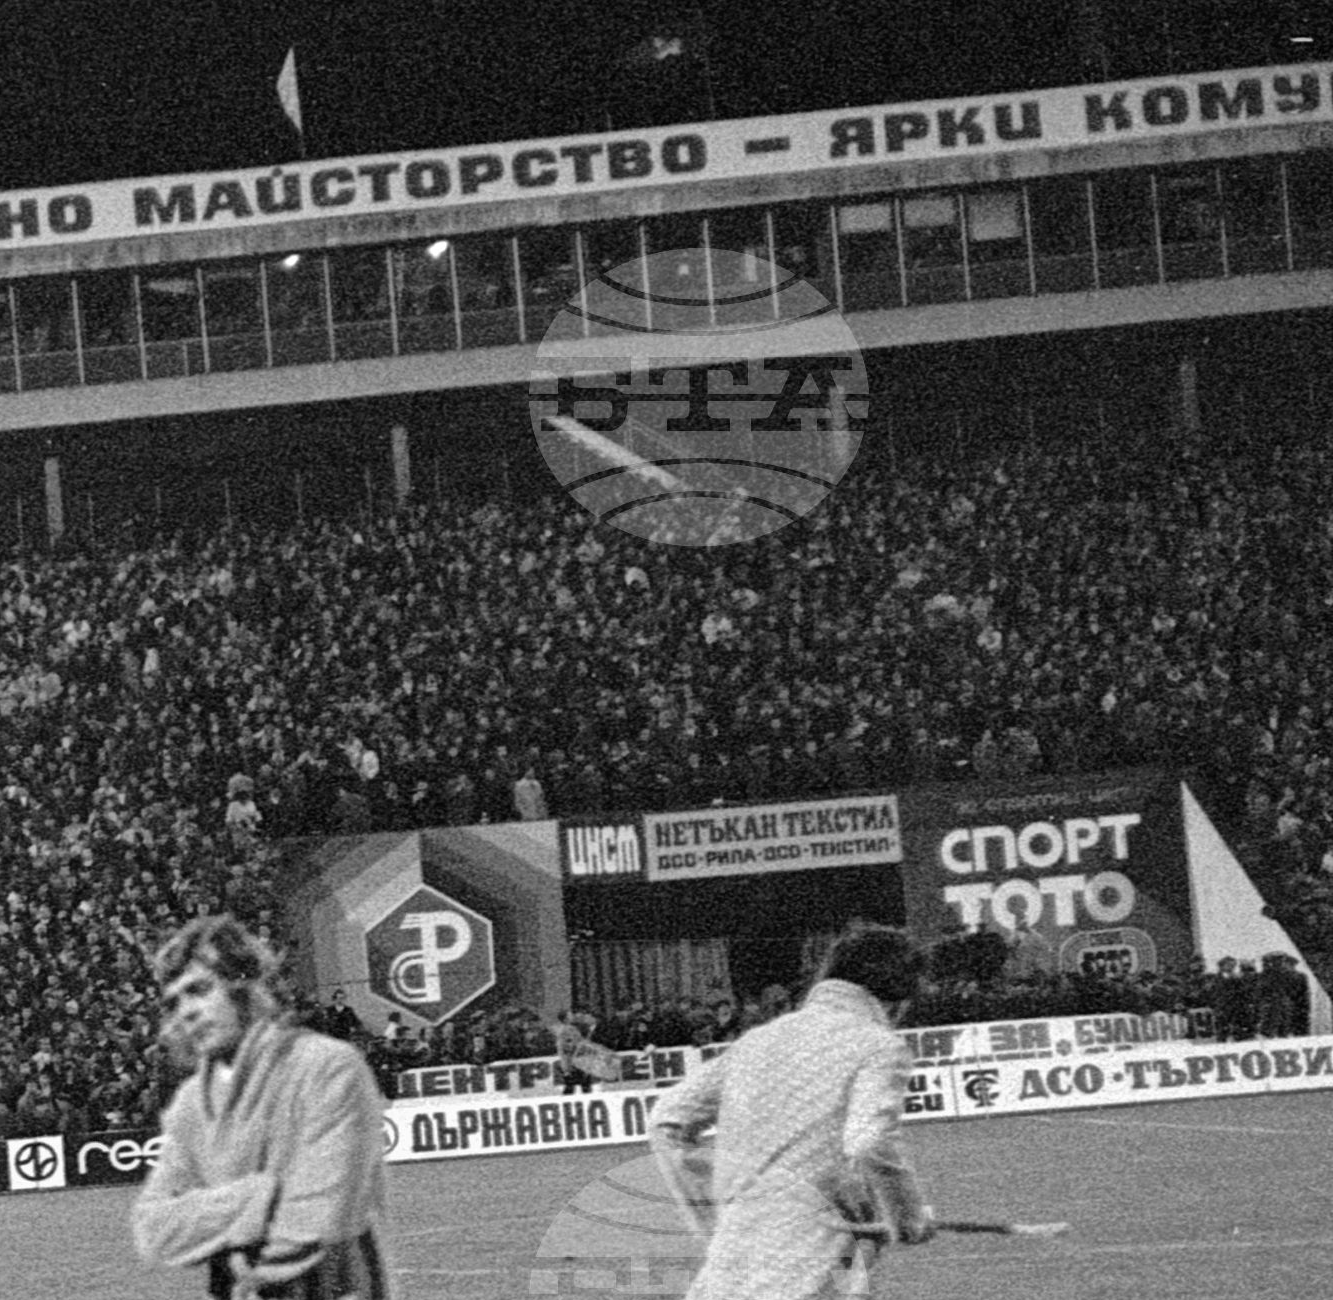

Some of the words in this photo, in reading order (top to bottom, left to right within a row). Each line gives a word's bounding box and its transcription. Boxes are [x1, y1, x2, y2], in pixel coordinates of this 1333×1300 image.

[133, 133, 709, 226] МАЙСТОРСТВО
[830, 97, 1042, 158] ЯРКИ
[1084, 72, 1333, 134] КОМУ
[655, 813, 778, 848] НЕТЪКАН
[783, 804, 895, 838] ТЕКСТИЛ
[941, 813, 1141, 874] СПОРТ
[943, 871, 1135, 932] ТОТО
[411, 1100, 612, 1153] ДЪРЖАВНА
